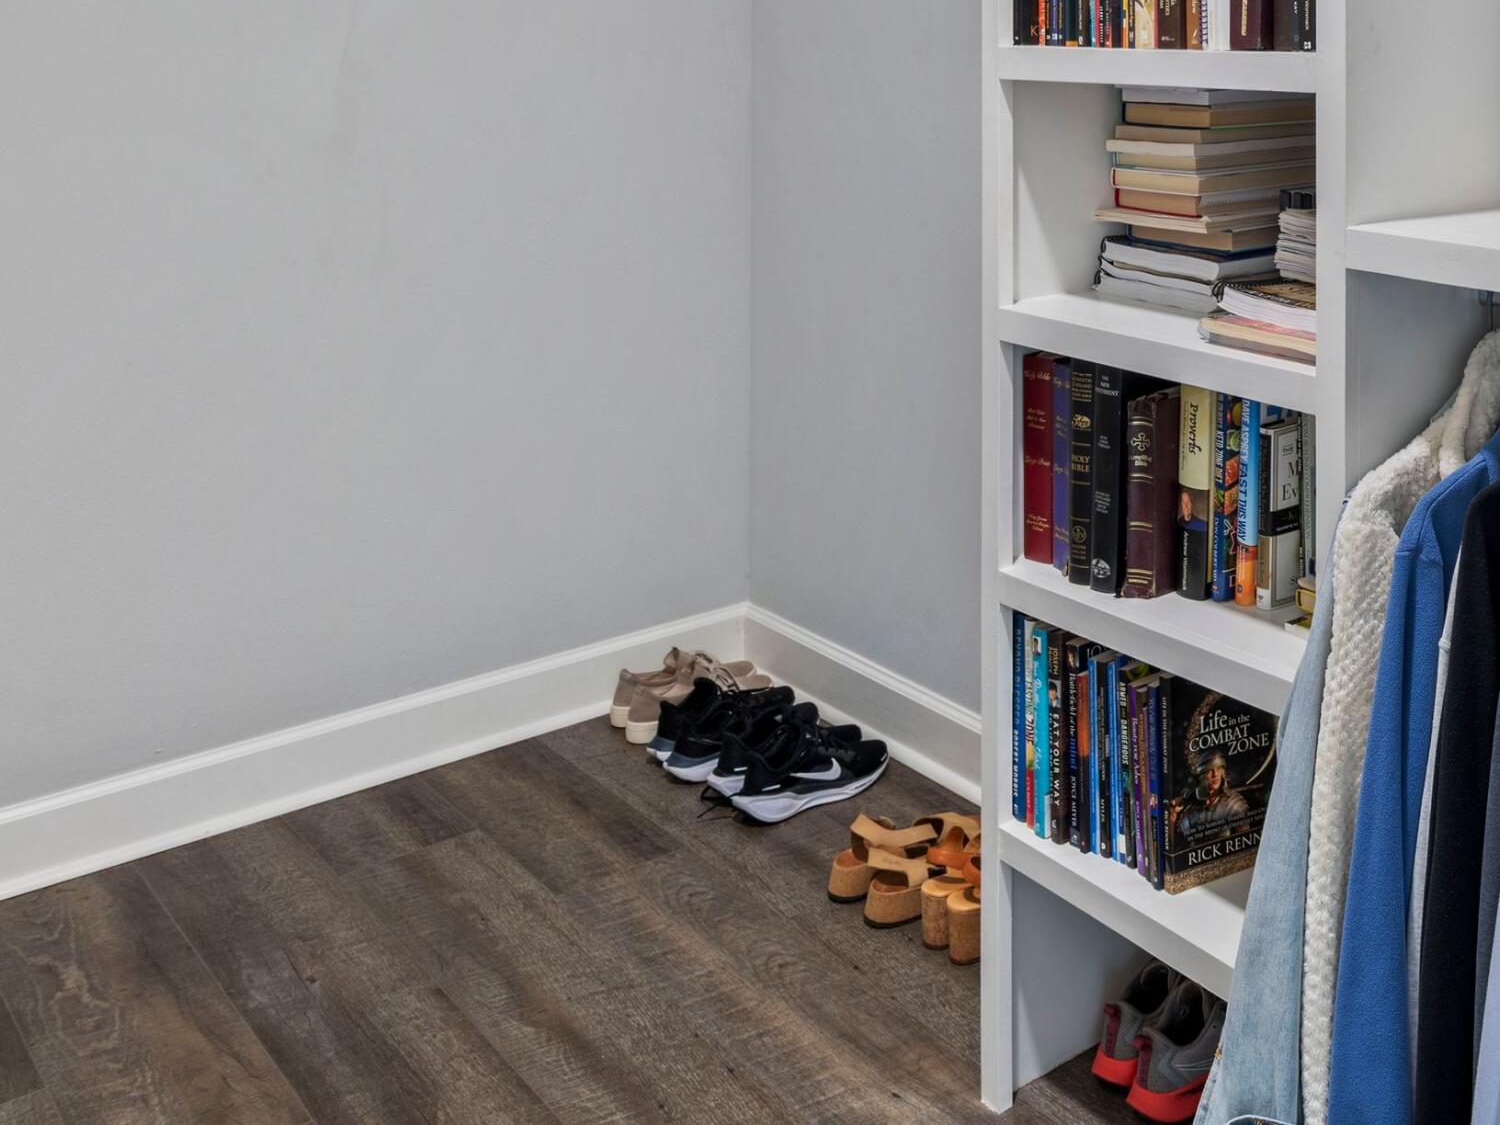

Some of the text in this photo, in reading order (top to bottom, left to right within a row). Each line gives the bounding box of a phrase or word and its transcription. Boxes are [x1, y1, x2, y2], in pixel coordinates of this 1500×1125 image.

[1188, 403, 1202, 455] Proverbs
[1241, 425, 1249, 462] ASPREY
[1215, 431, 1225, 484] KETO ZONE DIET
[1240, 463, 1248, 497] FAST
[1239, 499, 1247, 519] THIS
[1238, 521, 1247, 541] WAY
[1200, 710, 1250, 733] Life in the
[1189, 724, 1250, 751] COMBAT
[1228, 733, 1269, 755] ZONE
[1188, 832, 1262, 865] RICK RENN
